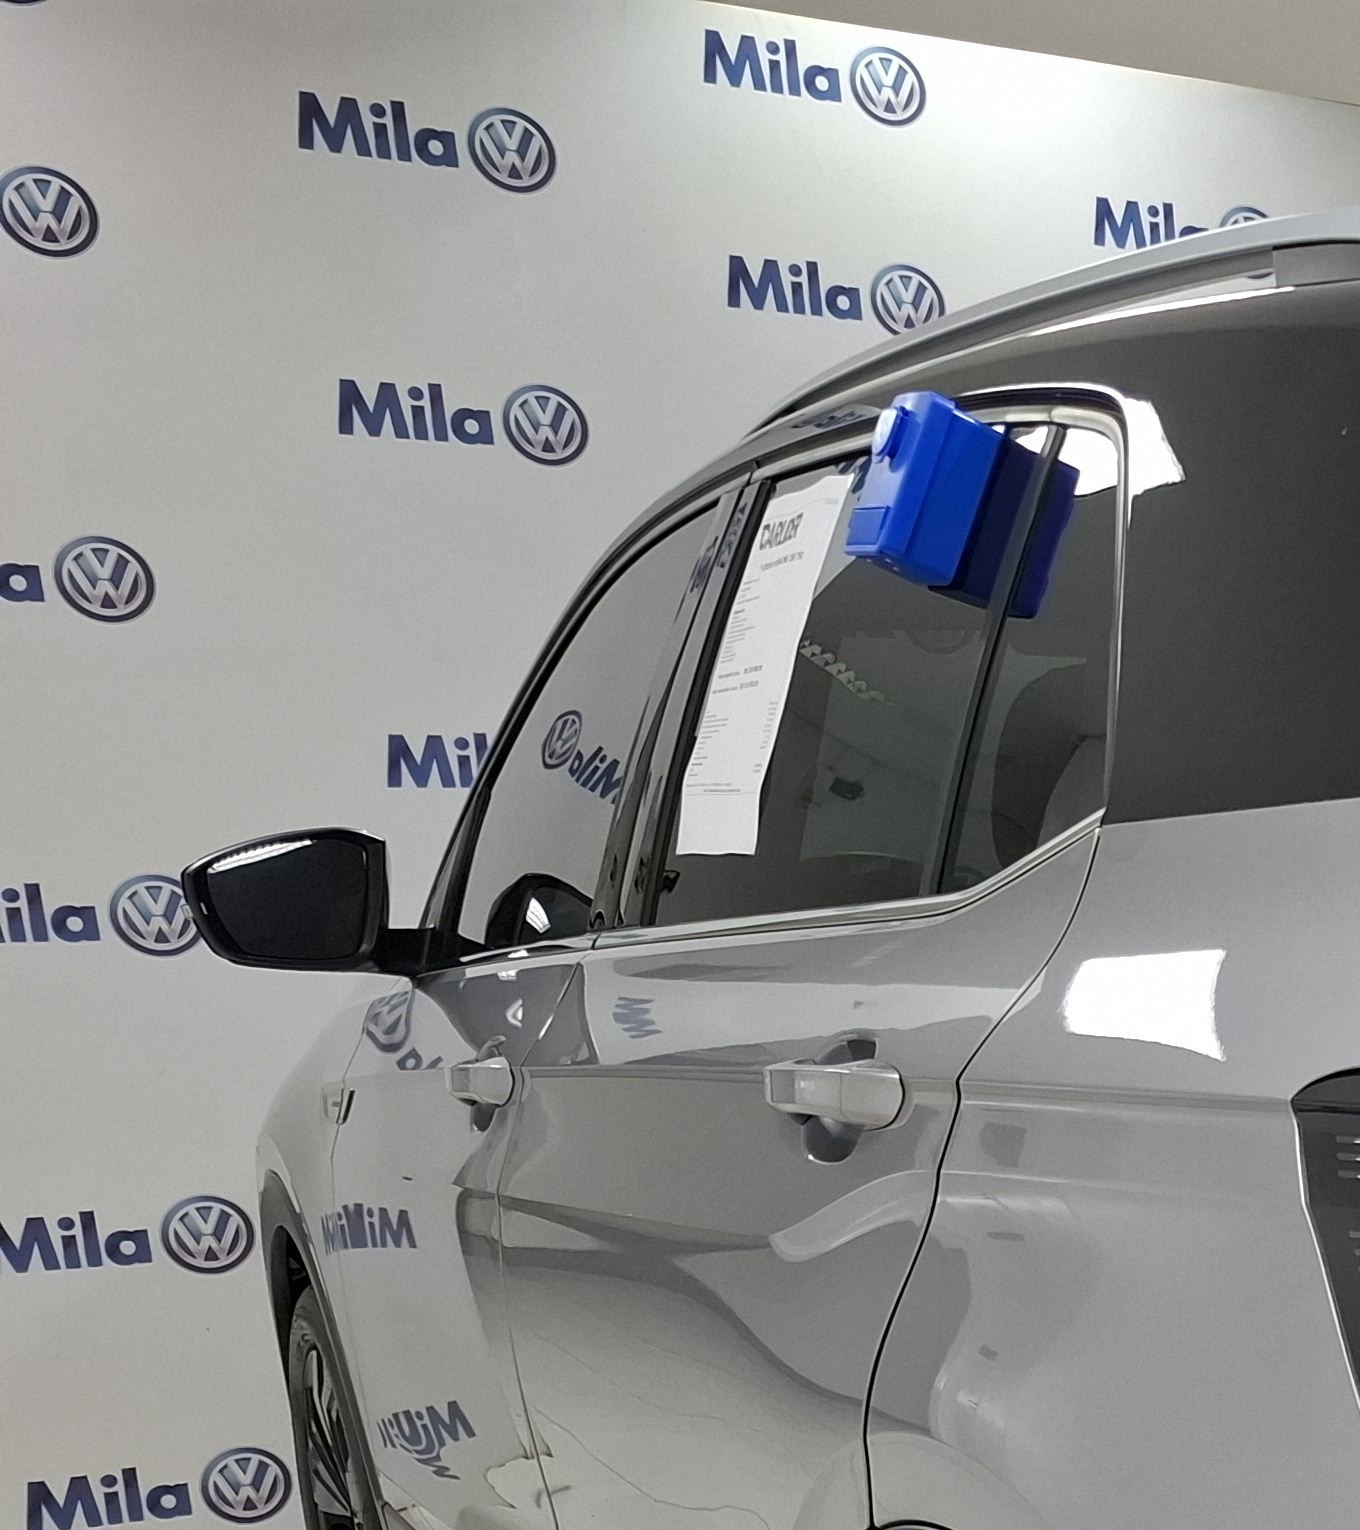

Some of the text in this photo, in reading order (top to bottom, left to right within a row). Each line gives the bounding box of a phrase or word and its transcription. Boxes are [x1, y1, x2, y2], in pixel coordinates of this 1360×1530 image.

[704, 29, 841, 102] Mila
[299, 91, 459, 168] Mila
[728, 255, 862, 320] Mila
[339, 379, 494, 445] Mila
[388, 733, 488, 789] Mil
[0, 883, 100, 943] ila
[0, 1211, 152, 1273] Mila
